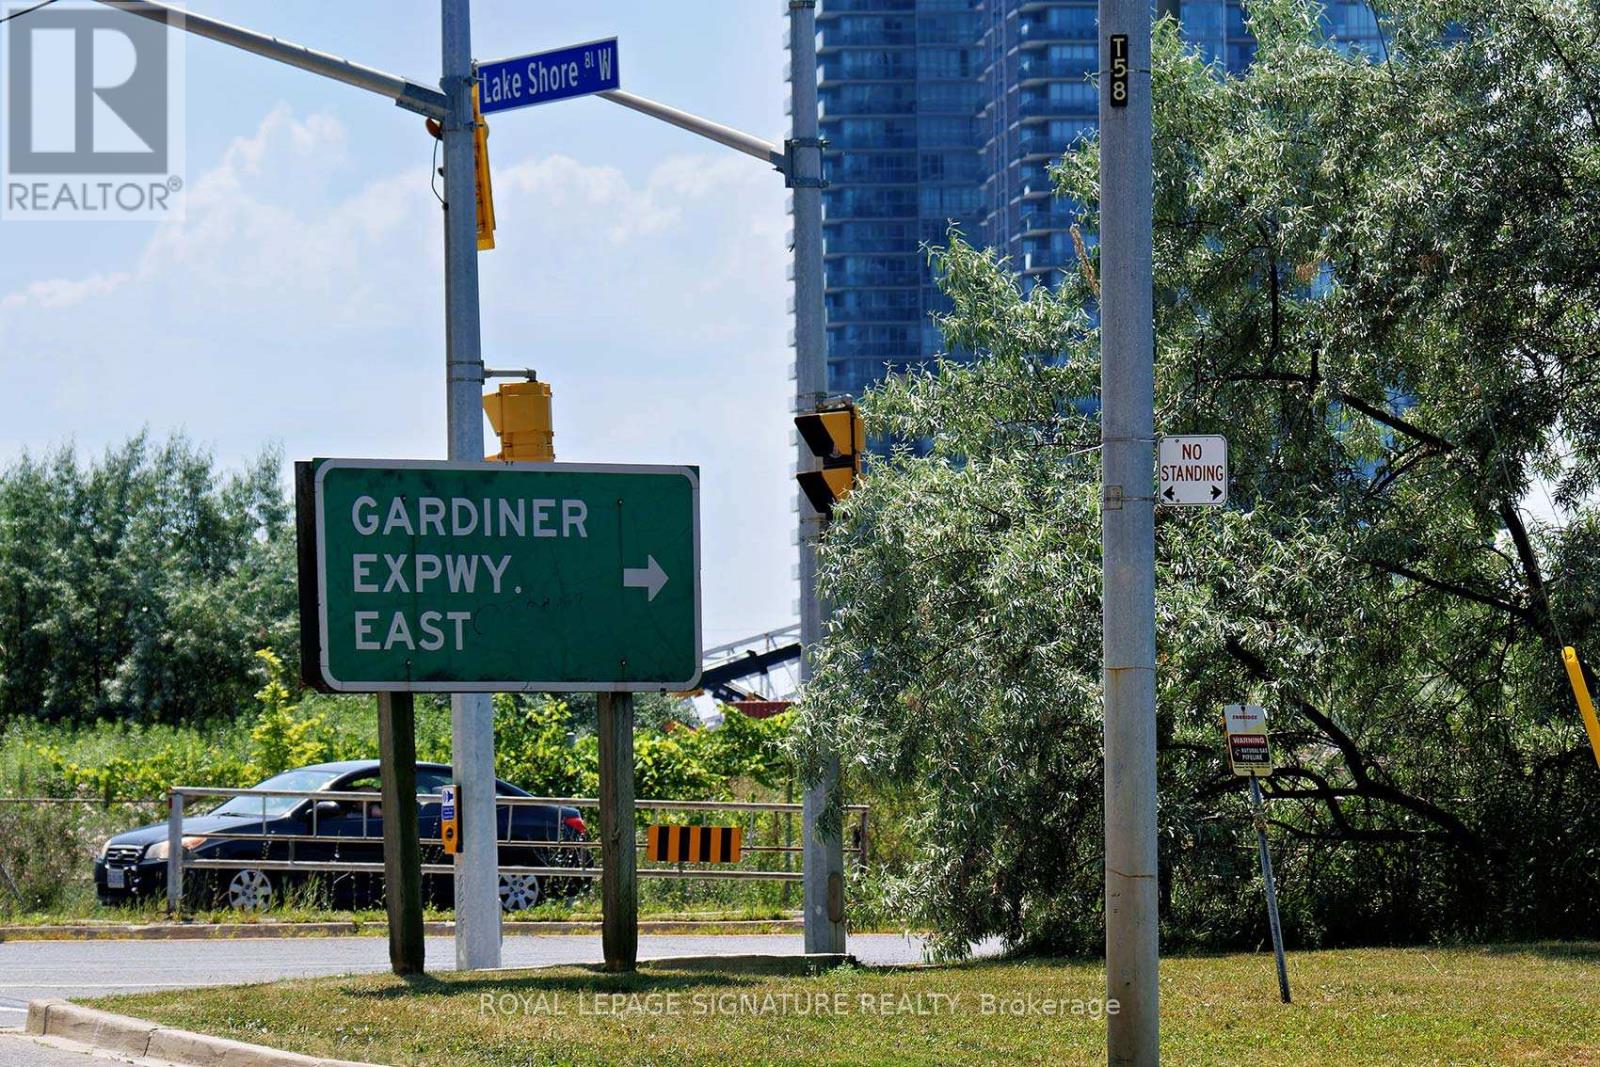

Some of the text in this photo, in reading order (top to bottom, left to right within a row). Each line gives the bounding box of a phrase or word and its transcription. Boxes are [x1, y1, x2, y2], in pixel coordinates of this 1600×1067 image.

[483, 47, 612, 104] Lake Shore Bl W
[1113, 38, 1126, 101] T58
[1182, 444, 1202, 460] NO
[1161, 465, 1223, 482] STANDING
[351, 495, 588, 538] GARDINER
[352, 554, 522, 594] EXPWY.
[354, 610, 472, 651] EAST
